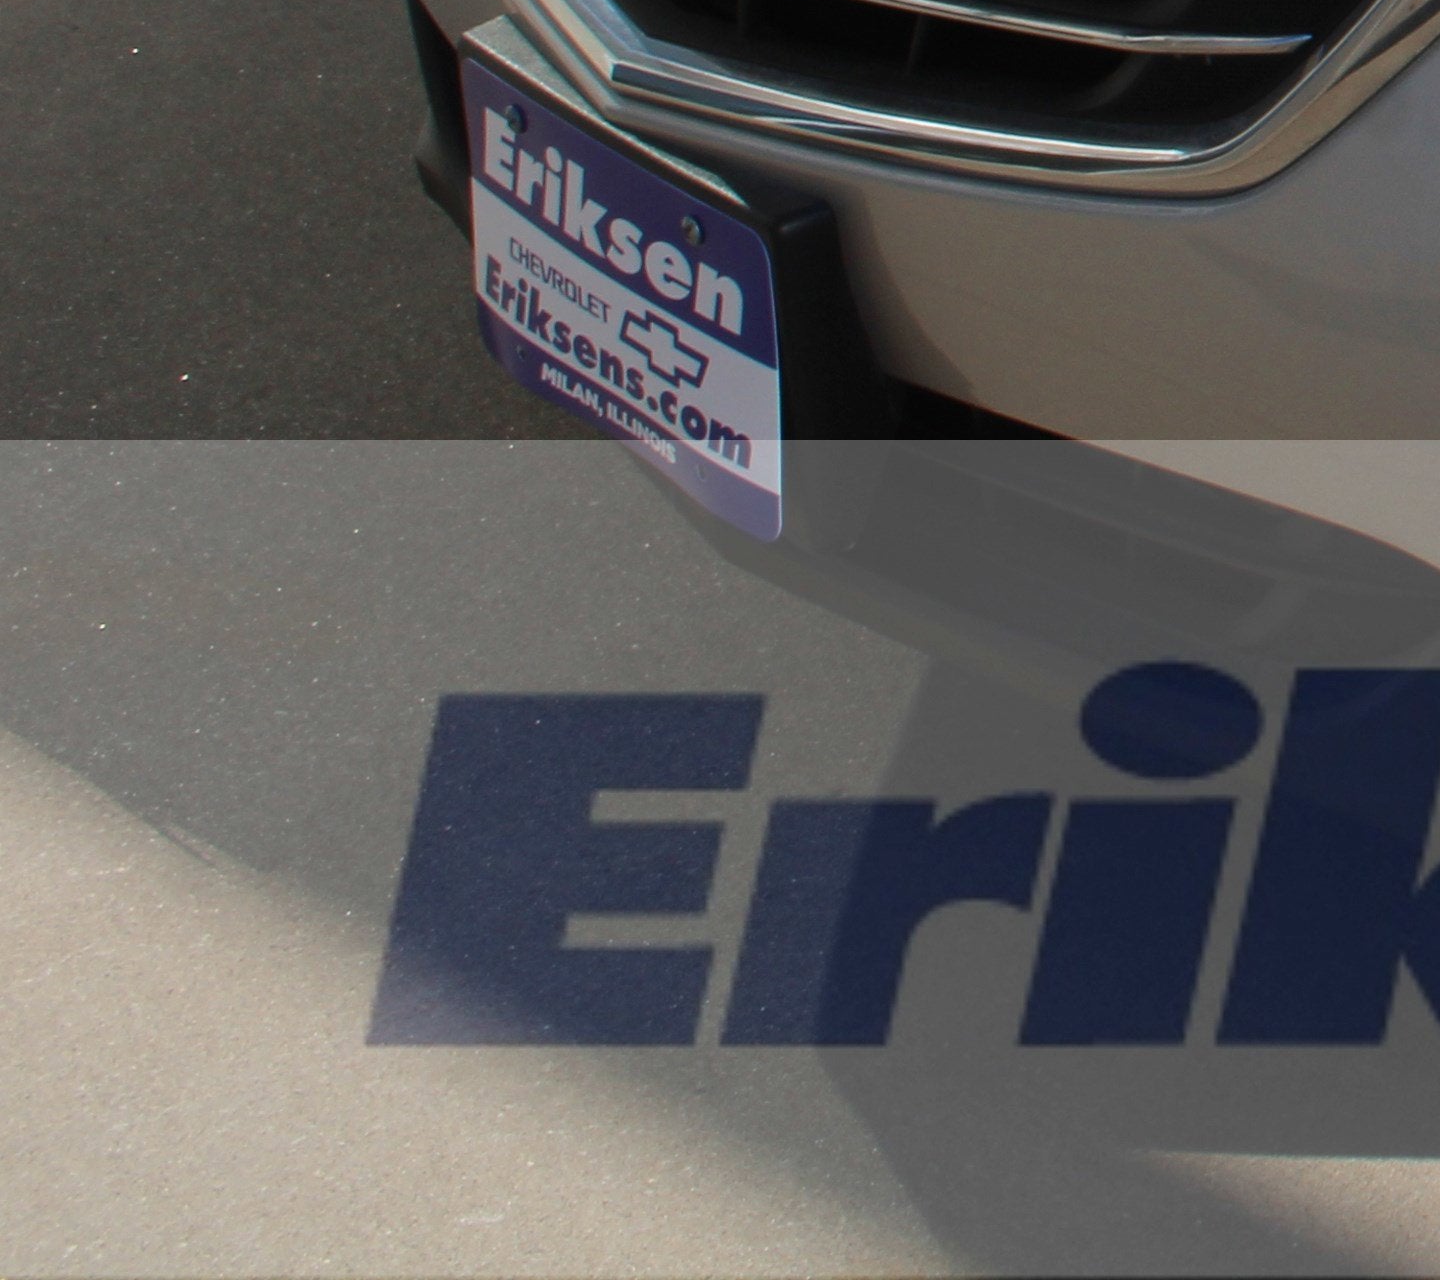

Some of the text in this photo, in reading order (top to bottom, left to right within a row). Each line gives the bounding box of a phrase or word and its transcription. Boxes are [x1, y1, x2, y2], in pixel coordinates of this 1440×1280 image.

[482, 107, 746, 336] Eriksen
[508, 236, 612, 324] CHEVROLET
[484, 252, 753, 470] Eriksens.com
[540, 362, 678, 466] MILAN, ILLINOIS
